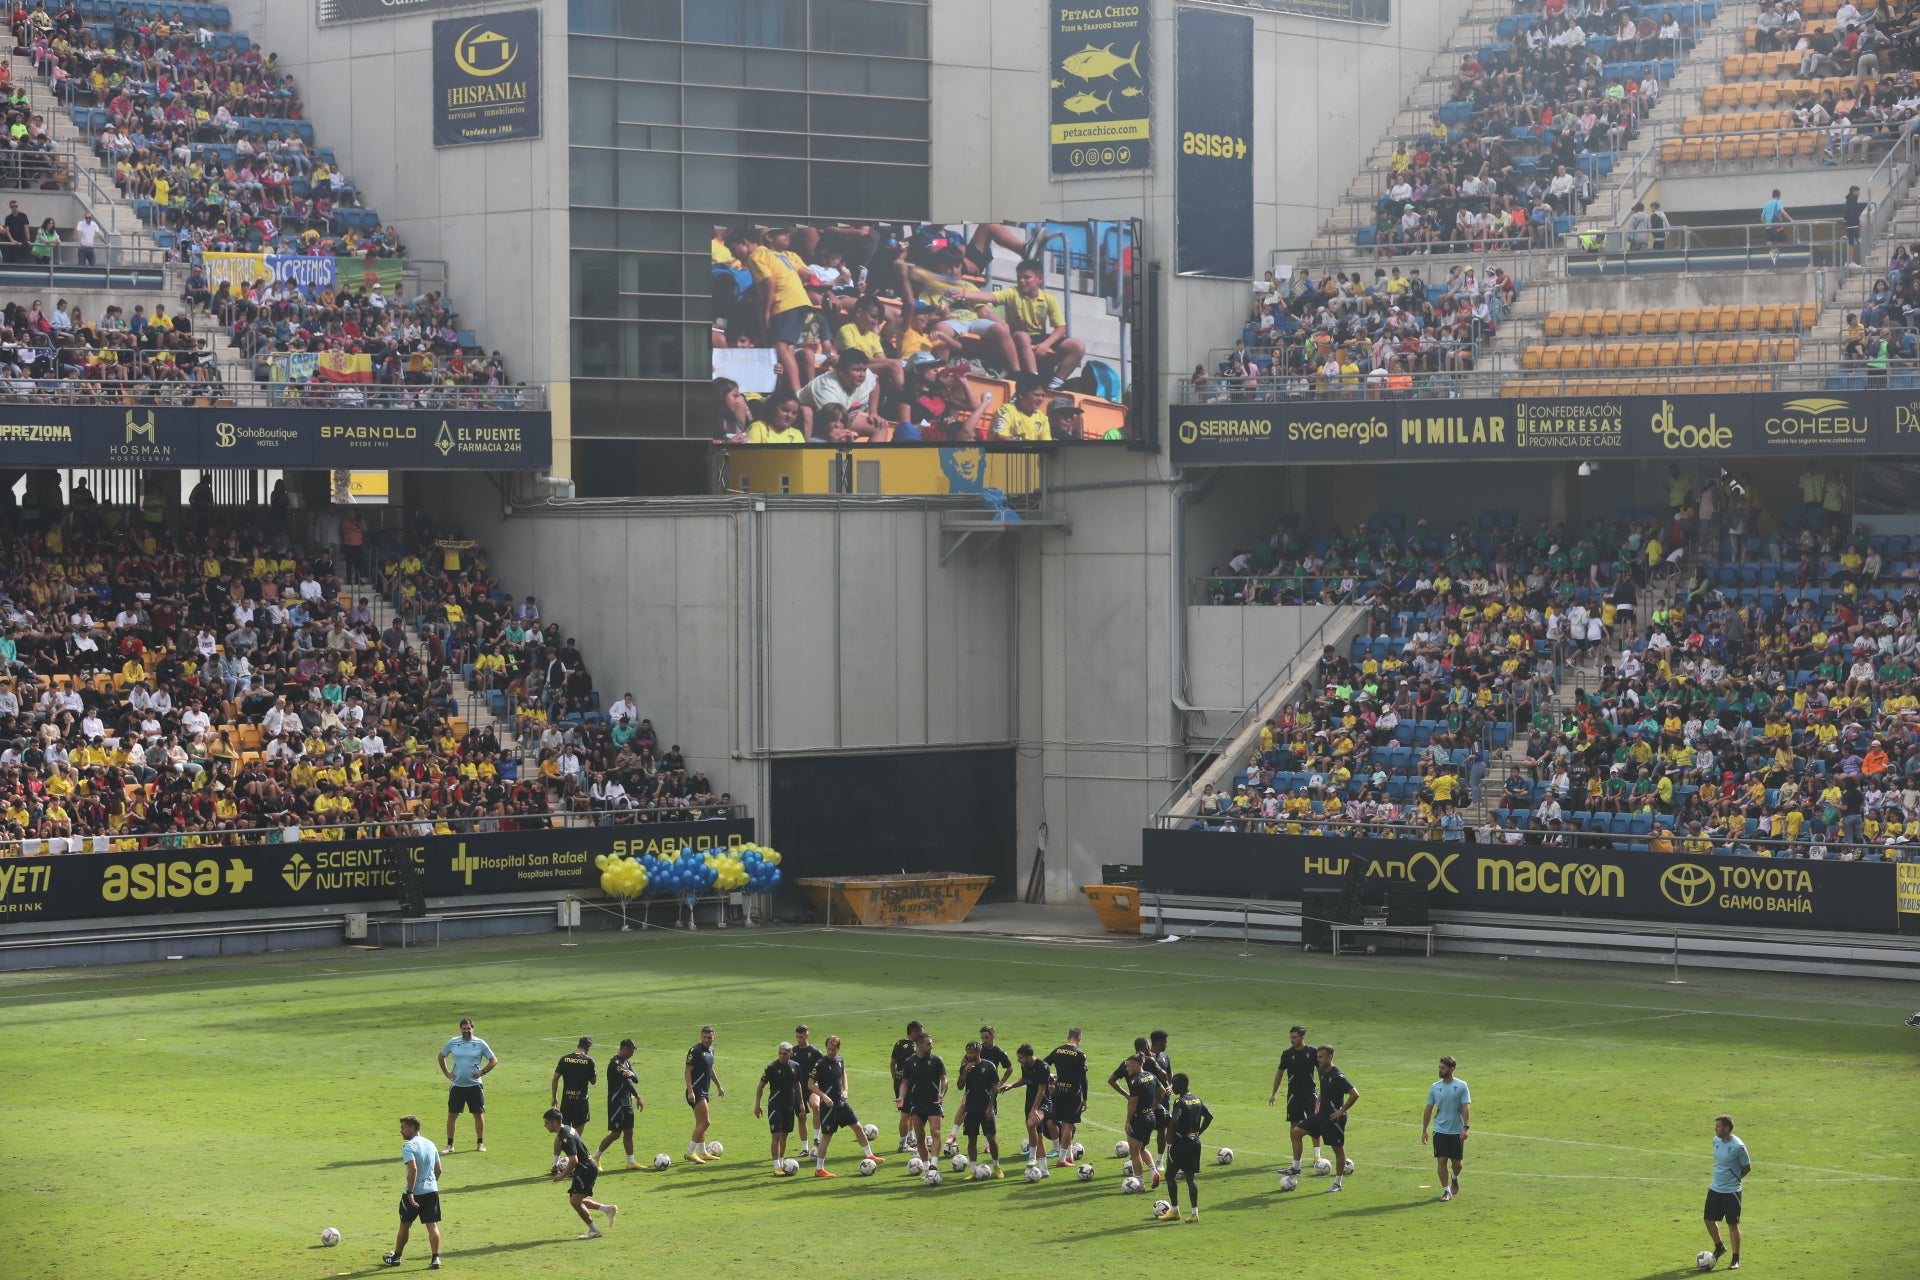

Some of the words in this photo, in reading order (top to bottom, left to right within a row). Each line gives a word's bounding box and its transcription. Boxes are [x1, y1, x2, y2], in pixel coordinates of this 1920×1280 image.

[1061, 9, 1102, 20] PETACA
[1105, 5, 1139, 17] CHICO
[453, 81, 522, 105] HISPANIA
[448, 110, 476, 120] servicios
[484, 105, 525, 117] inmobiliarios
[1063, 124, 1138, 140] petacachico.com
[1183, 131, 1233, 158] asisa
[1529, 403, 1622, 418] CONFEDERACIÓN
[0, 424, 72, 441] PREZIONA
[320, 426, 416, 438] SPAGNOLO
[1200, 419, 1272, 436] SERRANO
[1427, 416, 1505, 443] MILAR
[1529, 419, 1622, 433] EMPRESAS
[1765, 417, 1868, 434] COHEBU
[237, 428, 297, 441] SohoBoutique
[458, 428, 471, 440] EL
[475, 428, 521, 440] PUENTE
[1529, 437, 1577, 448] PROVINCIA
[1580, 437, 1591, 447] DE
[1594, 434, 1621, 447] CÁDIZ
[110, 445, 170, 455] HOSMAN
[458, 443, 501, 452] FARMACIA
[504, 443, 521, 452] 24H
[613, 834, 742, 856] SPAGNOLO
[480, 855, 525, 870] Hospital
[528, 854, 549, 865] San
[552, 850, 587, 864] Rafael
[102, 859, 220, 901] asisa
[518, 871, 553, 879] Hospitales
[554, 867, 582, 875] Pascual
[1477, 858, 1625, 897] macron
[1719, 866, 1813, 893] TOYOTA
[1719, 894, 1764, 910] GAMO
[1767, 894, 1813, 913] BAHÍA
